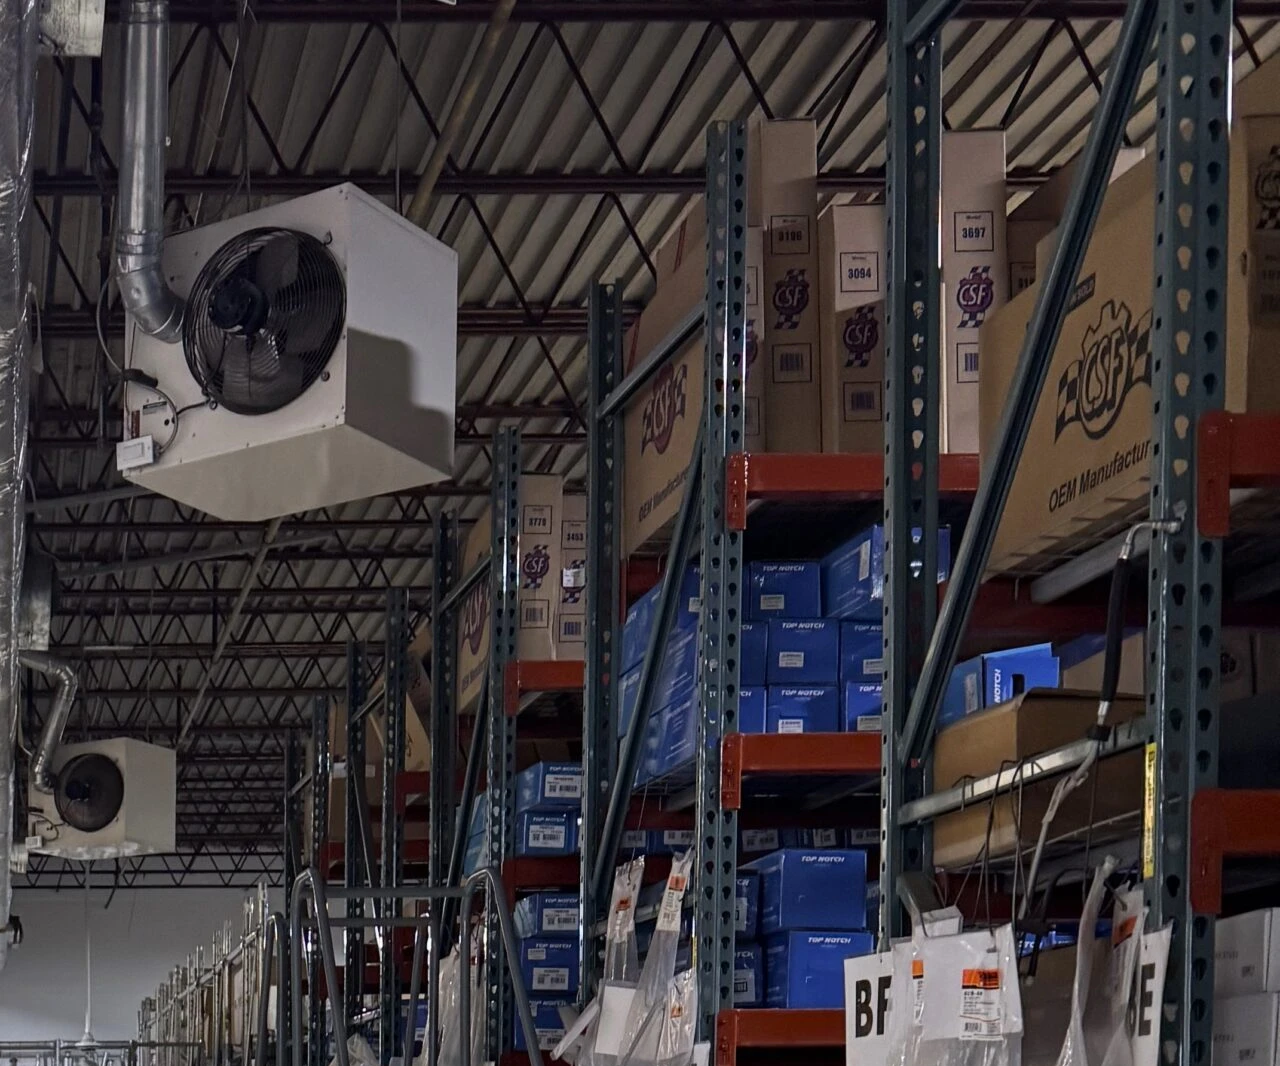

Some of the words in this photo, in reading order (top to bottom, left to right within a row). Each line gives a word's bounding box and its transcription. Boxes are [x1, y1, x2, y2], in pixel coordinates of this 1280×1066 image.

[848, 267, 872, 280] 3094
[774, 286, 802, 307] CSF
[959, 284, 986, 306] CSF
[845, 324, 871, 345] CSF
[1082, 328, 1129, 412] CSF
[1048, 482, 1077, 513] OEM
[1078, 439, 1152, 495] Manufactur
[524, 557, 545, 574] CSF
[855, 974, 892, 1039] BF
